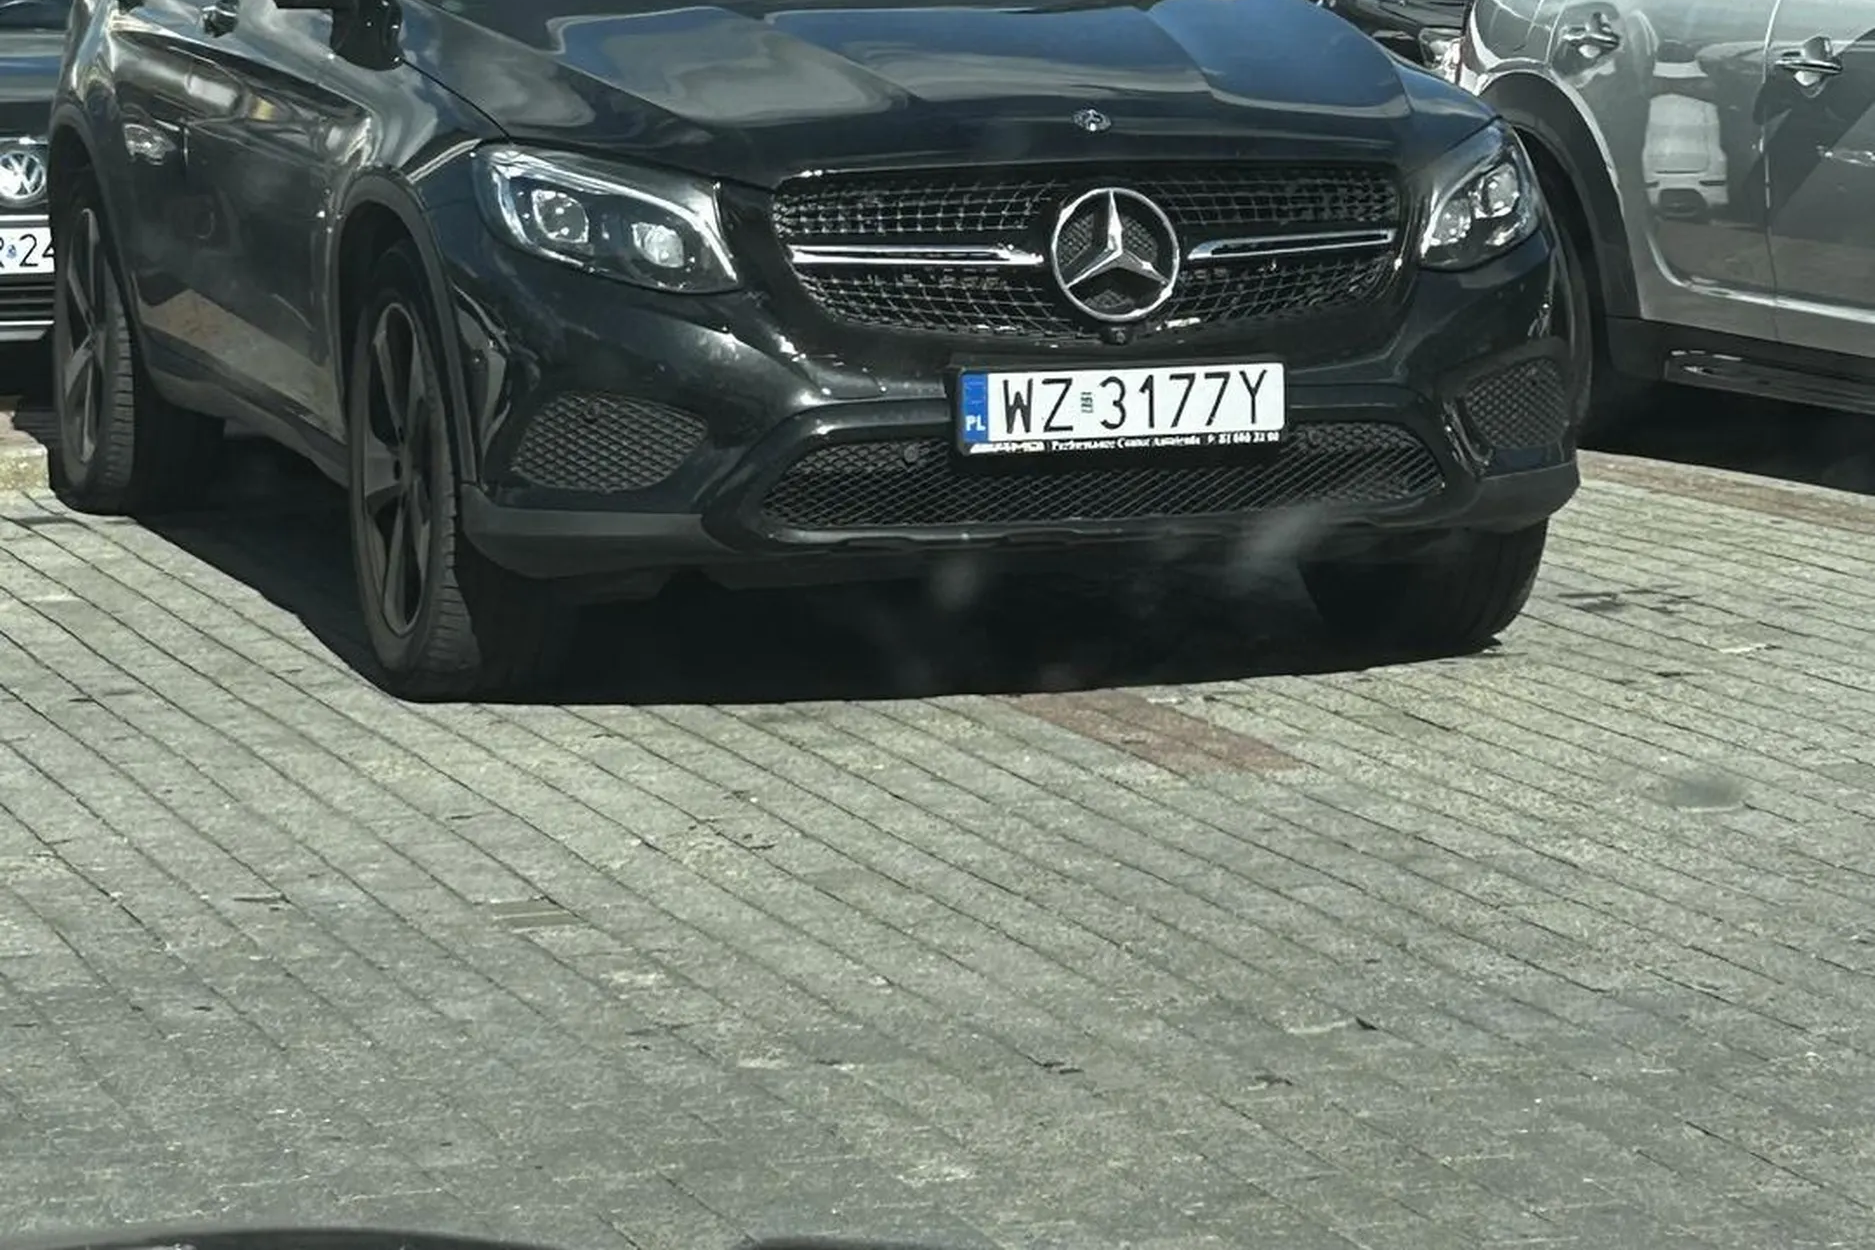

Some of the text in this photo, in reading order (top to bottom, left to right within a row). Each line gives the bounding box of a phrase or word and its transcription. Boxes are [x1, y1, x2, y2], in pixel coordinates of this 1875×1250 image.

[965, 414, 986, 432] PL
[1002, 369, 1268, 435] WZ 3177Y
